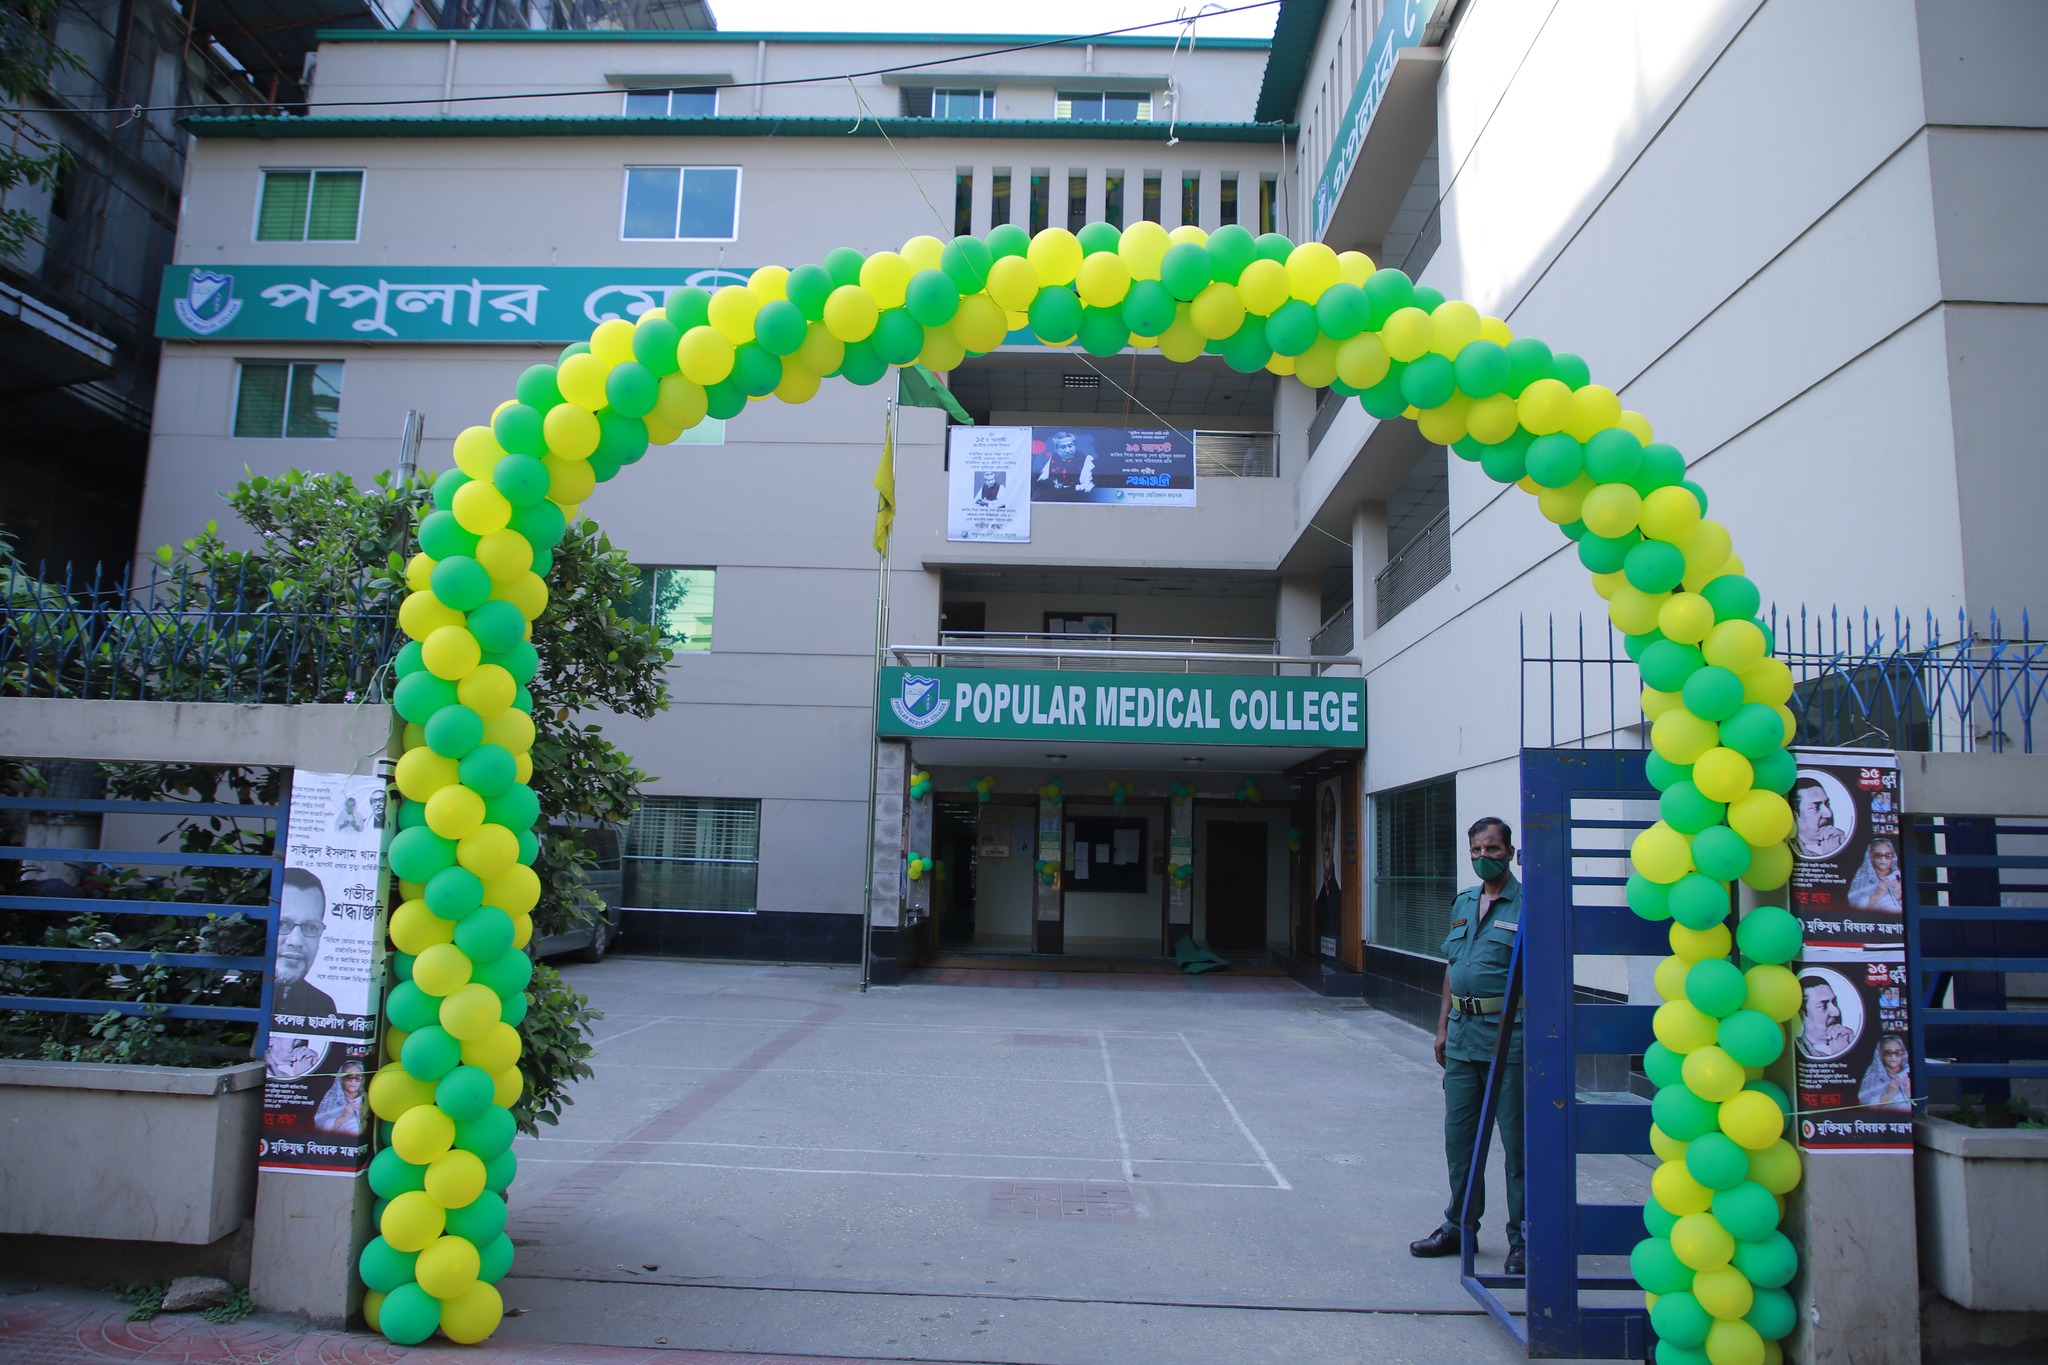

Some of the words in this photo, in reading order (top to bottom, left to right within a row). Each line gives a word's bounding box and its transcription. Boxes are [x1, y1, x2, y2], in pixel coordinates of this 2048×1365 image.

[260, 278, 550, 337] পপুলার
[954, 682, 1086, 726] POPULAR
[1096, 686, 1220, 728] MEDICAL
[1230, 689, 1358, 732] COLLEGE
[1861, 768, 1880, 778] ১৫
[291, 844, 322, 859] সাইদুল
[325, 845, 357, 859] ইসলাম
[360, 850, 378, 861] খান
[344, 884, 375, 901] গভীর
[332, 900, 384, 921] শ্রদ্ধাঞ্জলি
[1806, 918, 1841, 934] মুক্তিযুদ্ধ
[1843, 919, 1875, 933] বিষয়ক
[1868, 964, 1887, 974] ১৫
[274, 1014, 306, 1027] কলেজ
[308, 1013, 345, 1029] ছাত্রলীগ
[1816, 1120, 1852, 1136] মুক্তিযুদ্ধ
[1854, 1119, 1887, 1133] বিষয়ক
[270, 1139, 305, 1156] মুক্তিযুদ্ধ
[307, 1141, 338, 1155] বিষয়ক
